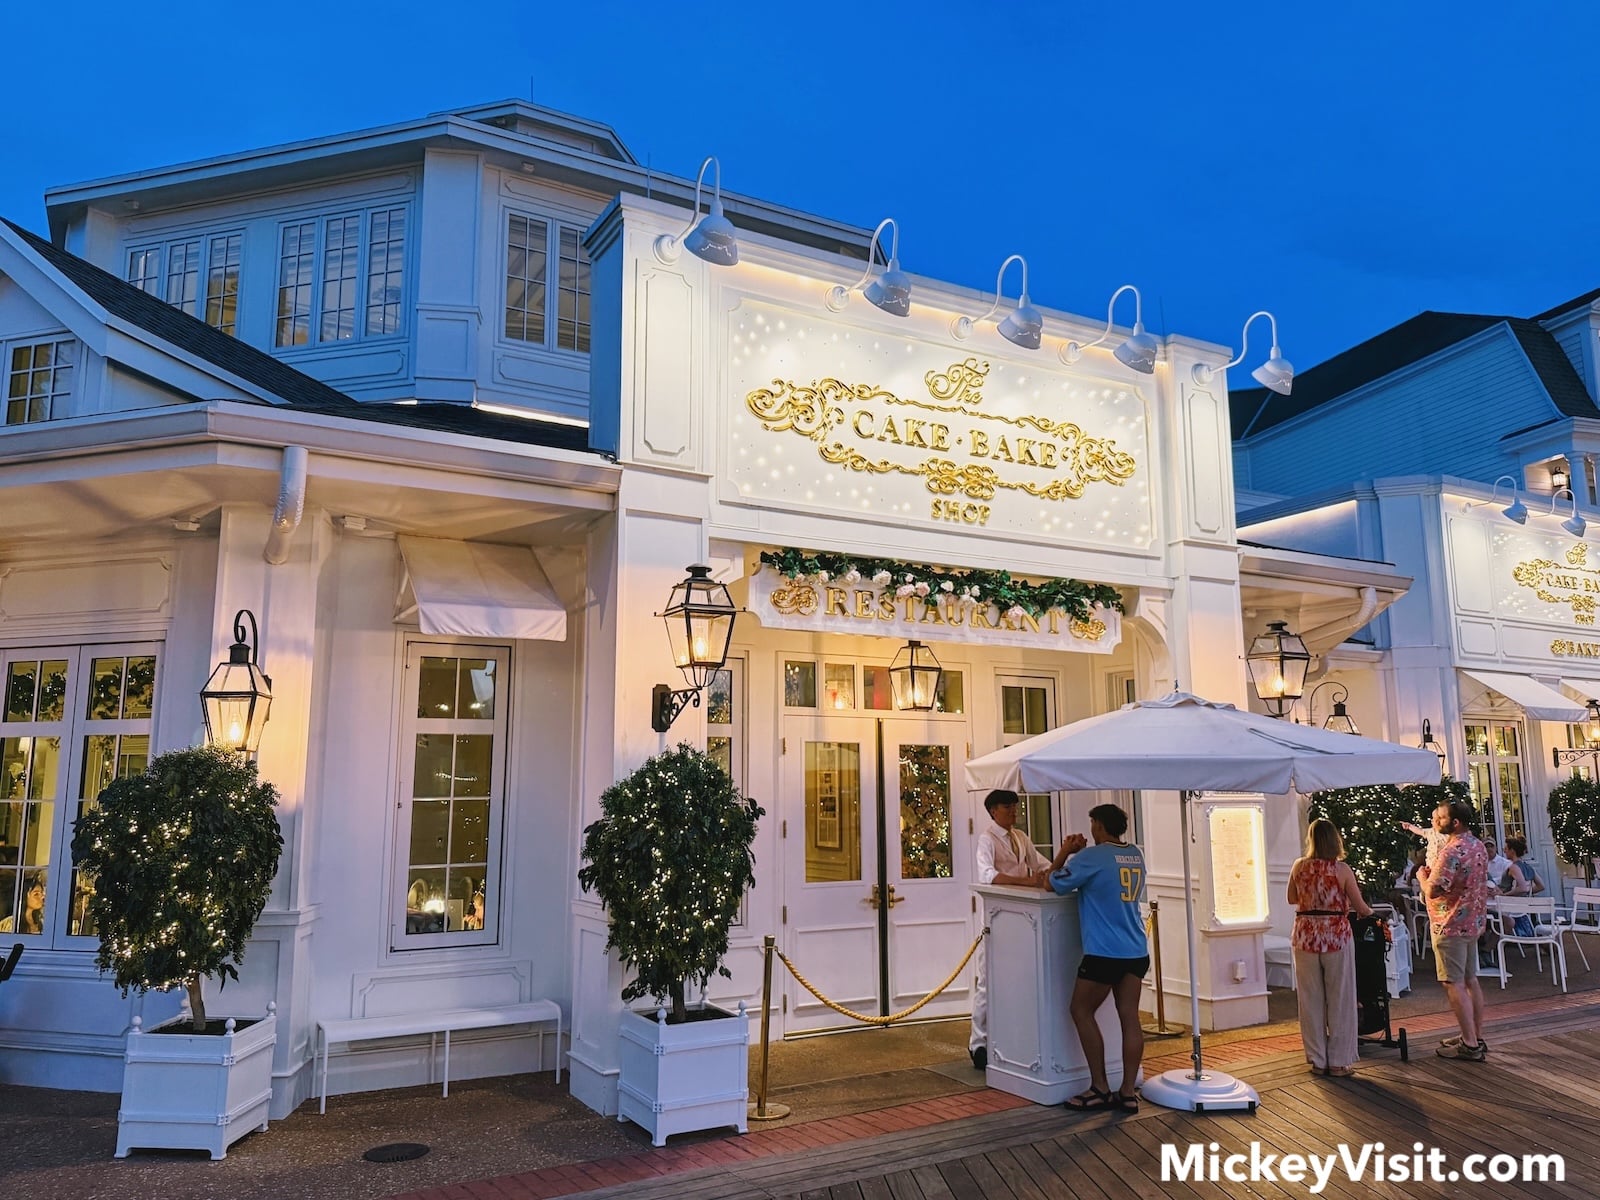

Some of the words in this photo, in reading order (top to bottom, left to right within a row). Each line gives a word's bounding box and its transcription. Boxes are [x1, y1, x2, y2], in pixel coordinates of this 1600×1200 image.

[925, 357, 990, 404] The
[851, 410, 950, 452] CAKE
[968, 429, 1057, 468] BAKE
[931, 498, 991, 526] SHOP
[1120, 867, 1142, 902] 97
